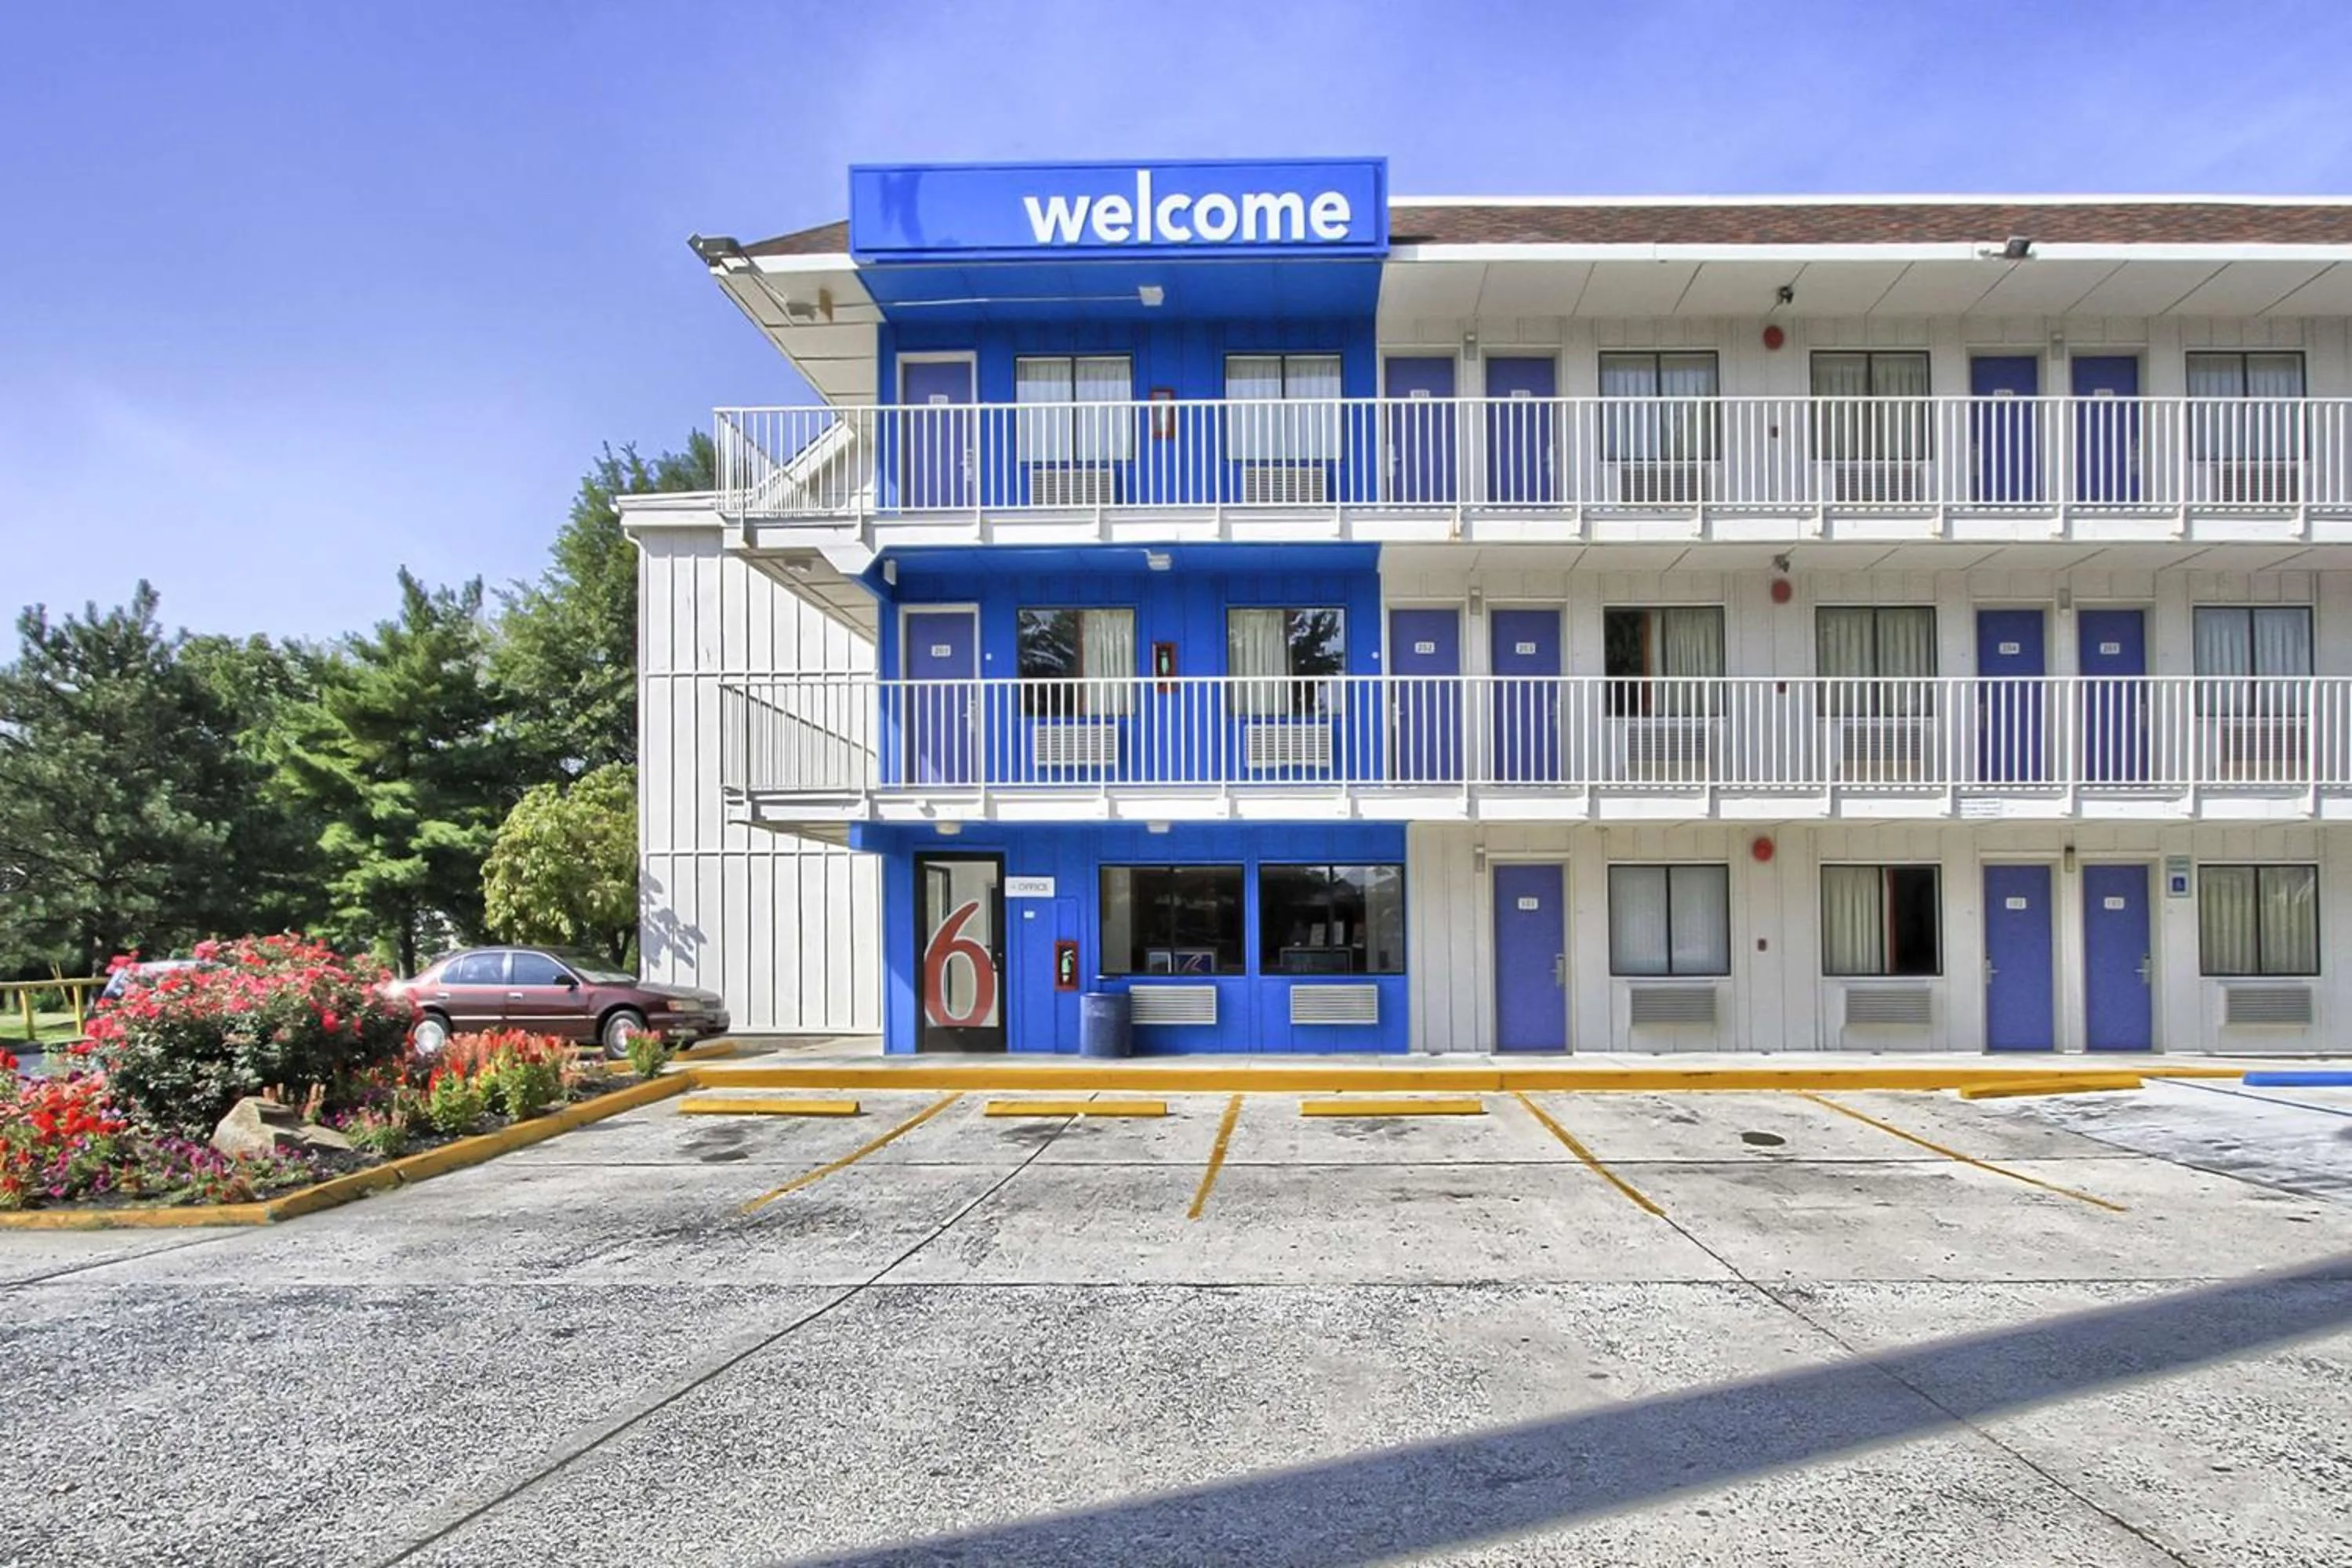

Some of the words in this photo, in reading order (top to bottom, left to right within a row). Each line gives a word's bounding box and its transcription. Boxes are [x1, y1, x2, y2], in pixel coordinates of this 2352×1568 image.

[1023, 169, 1351, 244] welcome
[1018, 882, 1047, 891] OFFICE
[924, 898, 997, 1027] 6
